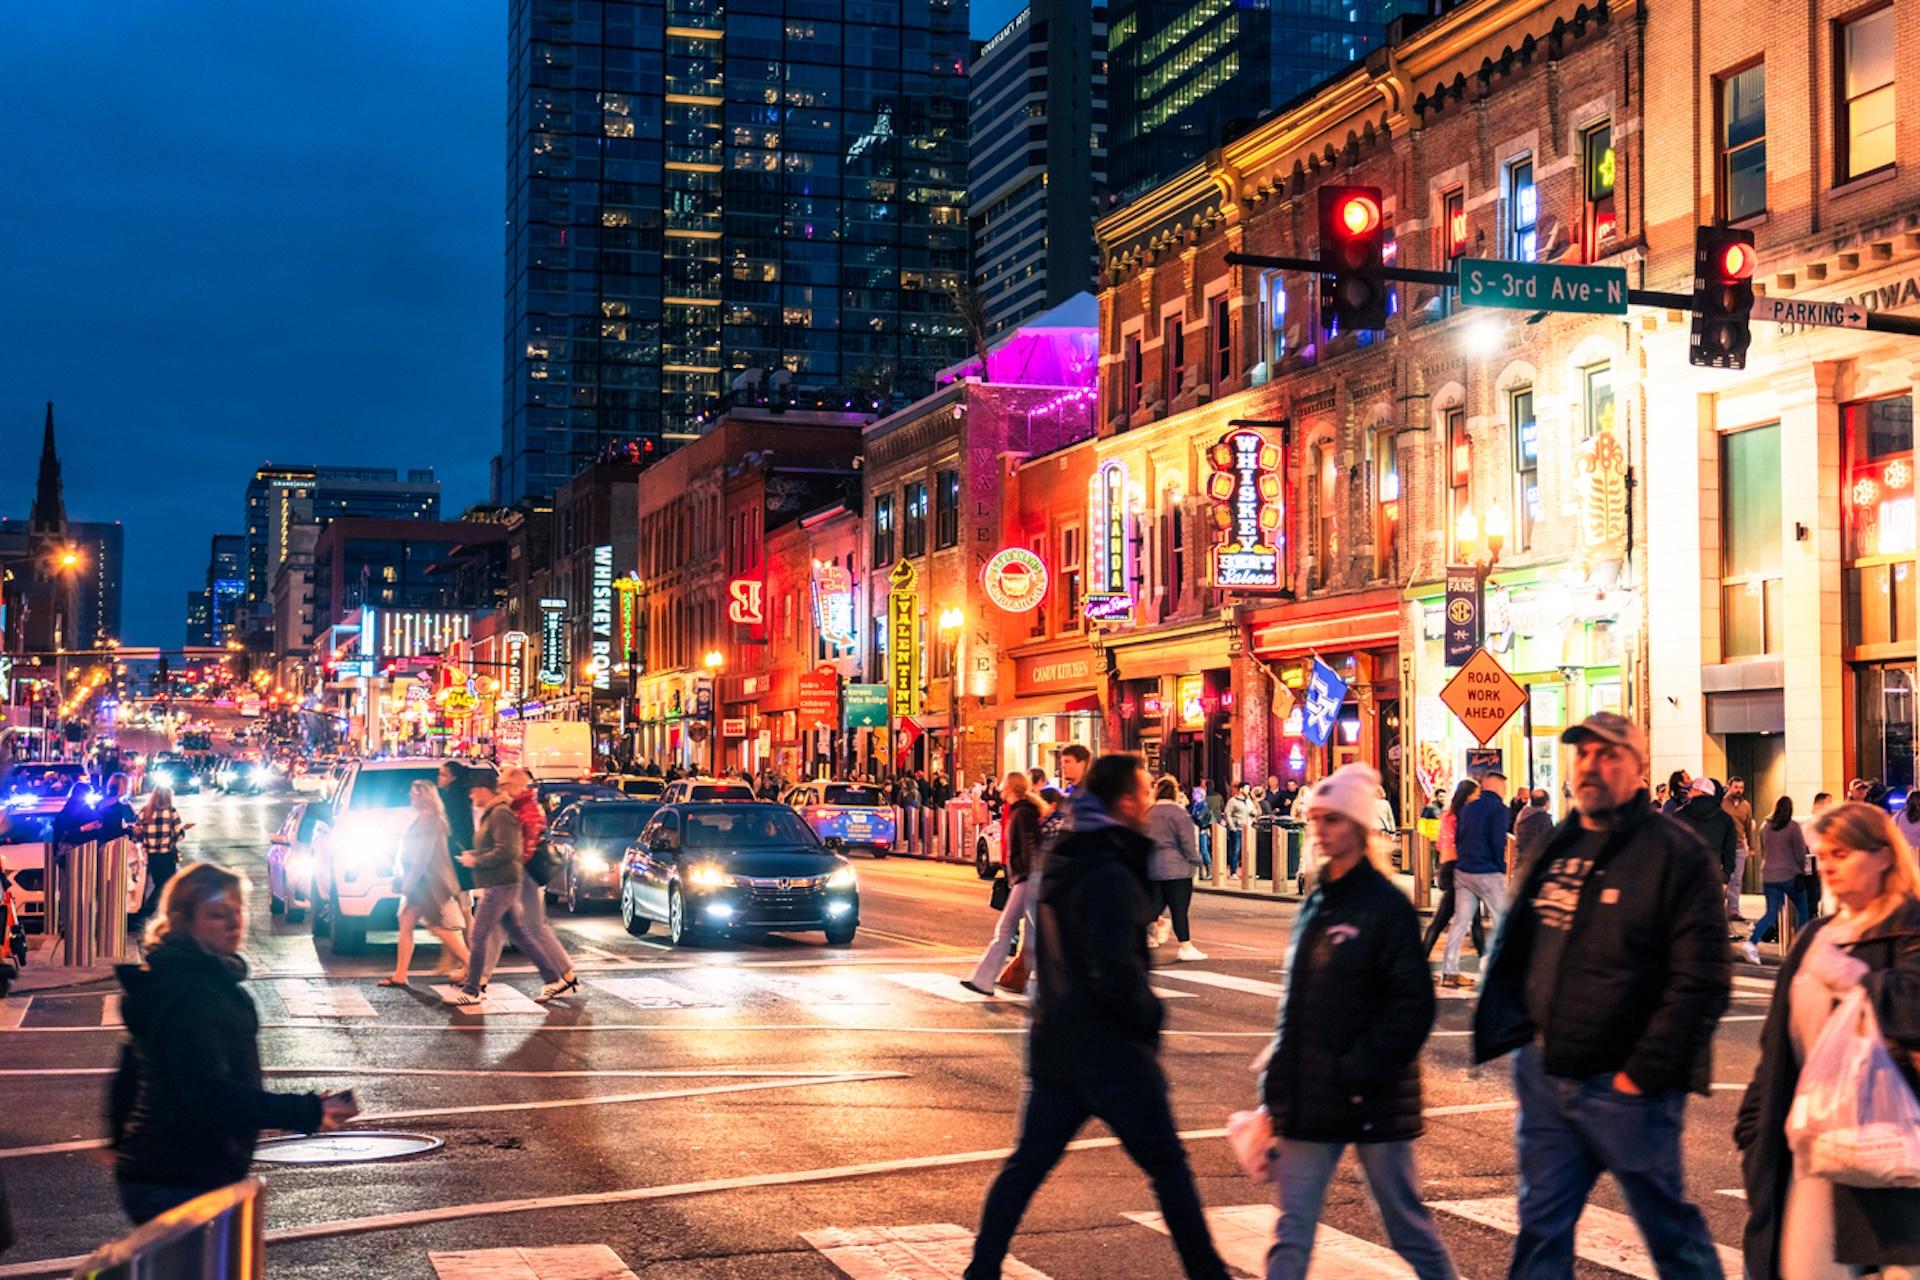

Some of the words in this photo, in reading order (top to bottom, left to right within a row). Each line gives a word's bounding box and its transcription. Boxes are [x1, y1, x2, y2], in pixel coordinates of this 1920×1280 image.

[1774, 301, 1844, 325] PARKING
[1234, 435, 1259, 552] WHISKEY
[1109, 471, 1122, 587] MIRANDA
[973, 447, 994, 672] VALENINE
[820, 567, 844, 580] Tin
[1218, 567, 1276, 584] Saloon
[593, 545, 613, 637] WHISKEY
[819, 578, 848, 593] Roof
[1447, 582, 1476, 593] FANS
[1450, 601, 1472, 622] SEC
[548, 611, 559, 672] WHISKEY
[592, 640, 611, 691] ROW
[896, 600, 912, 714] VALENTINE
[1033, 665, 1057, 683] CANDY
[1057, 660, 1089, 680] KITCHEN
[1468, 672, 1500, 684] ROAD
[1467, 690, 1501, 701] WORK
[1464, 707, 1505, 719] AHEAD
